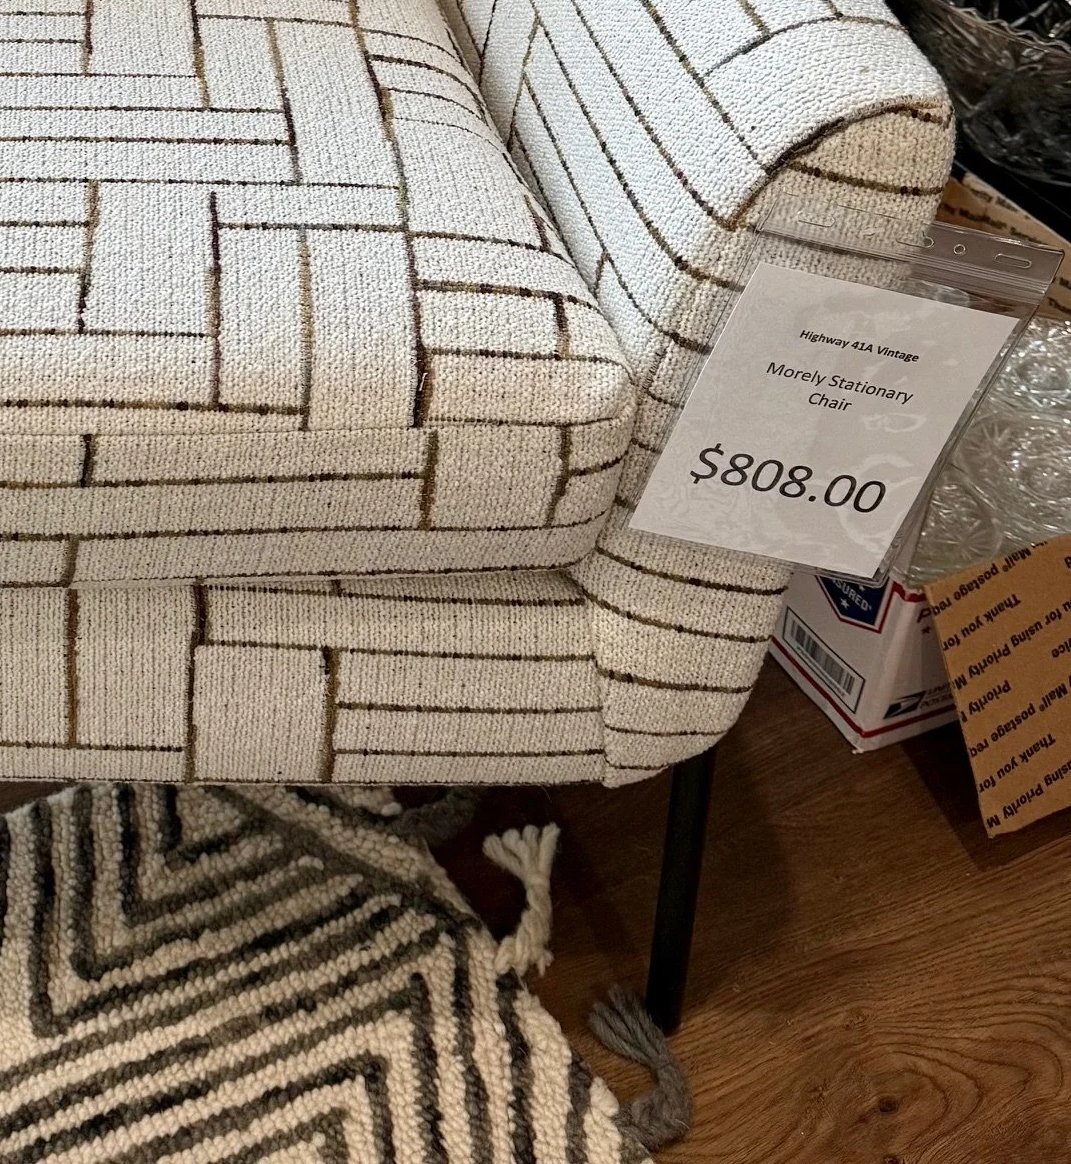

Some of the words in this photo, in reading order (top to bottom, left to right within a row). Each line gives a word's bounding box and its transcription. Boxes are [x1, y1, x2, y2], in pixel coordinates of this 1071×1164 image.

[800, 330, 849, 349] Highway
[851, 341, 874, 353] 41A
[877, 345, 920, 363] Vintage
[766, 362, 827, 387] Morely
[828, 375, 914, 405] Stationary
[808, 392, 852, 411] Chair
[689, 443, 886, 513] $808.00
[953, 563, 999, 601] postage
[984, 594, 1022, 622] Thank
[1044, 608, 1062, 625] for
[961, 615, 984, 638] you
[1010, 620, 1044, 647] using
[942, 634, 961, 651] for
[968, 643, 1012, 678] Priority
[968, 679, 1012, 715] Priority
[990, 703, 1036, 742] postage
[1019, 733, 1056, 763] Thank
[996, 756, 1019, 779] you
[979, 775, 996, 793] for
[1002, 783, 1044, 819] Priority
